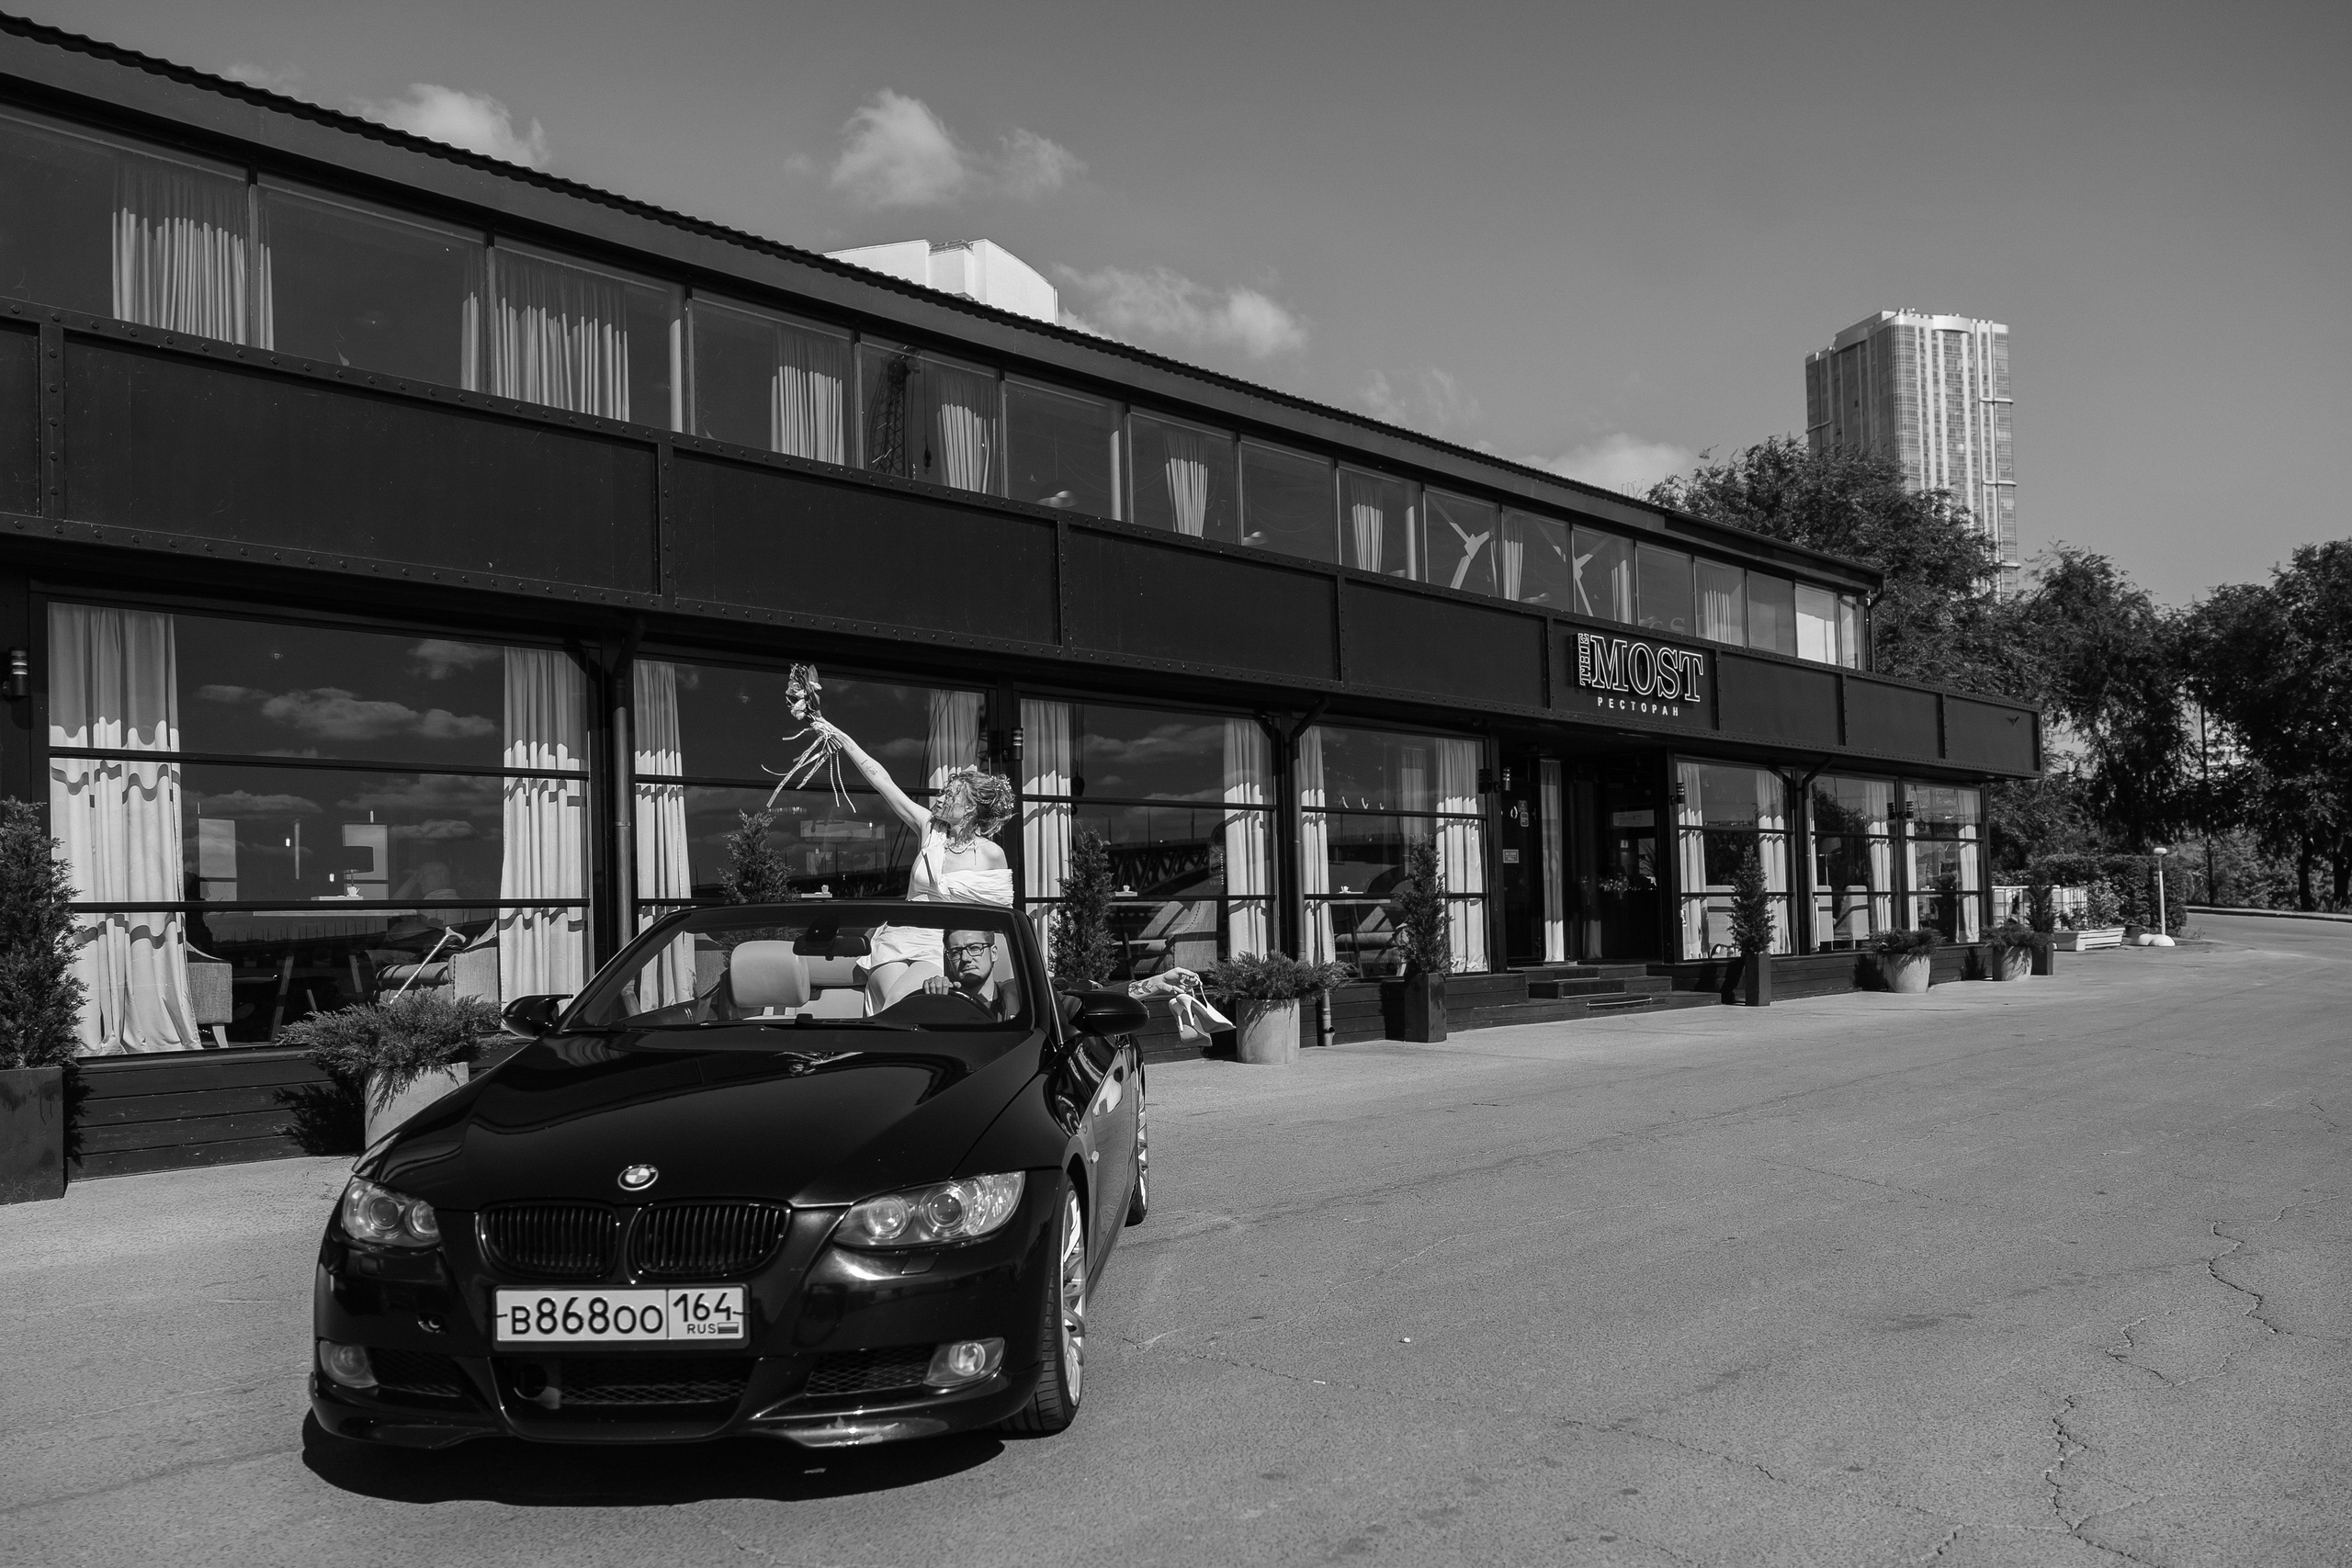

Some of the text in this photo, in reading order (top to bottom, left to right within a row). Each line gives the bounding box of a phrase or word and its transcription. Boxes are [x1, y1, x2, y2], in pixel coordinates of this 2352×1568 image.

[1577, 632, 1704, 702] THE MOST
[1597, 696, 1679, 717] РЕСТОРАН
[673, 1292, 733, 1323] 164
[687, 1323, 717, 1335] RUS
